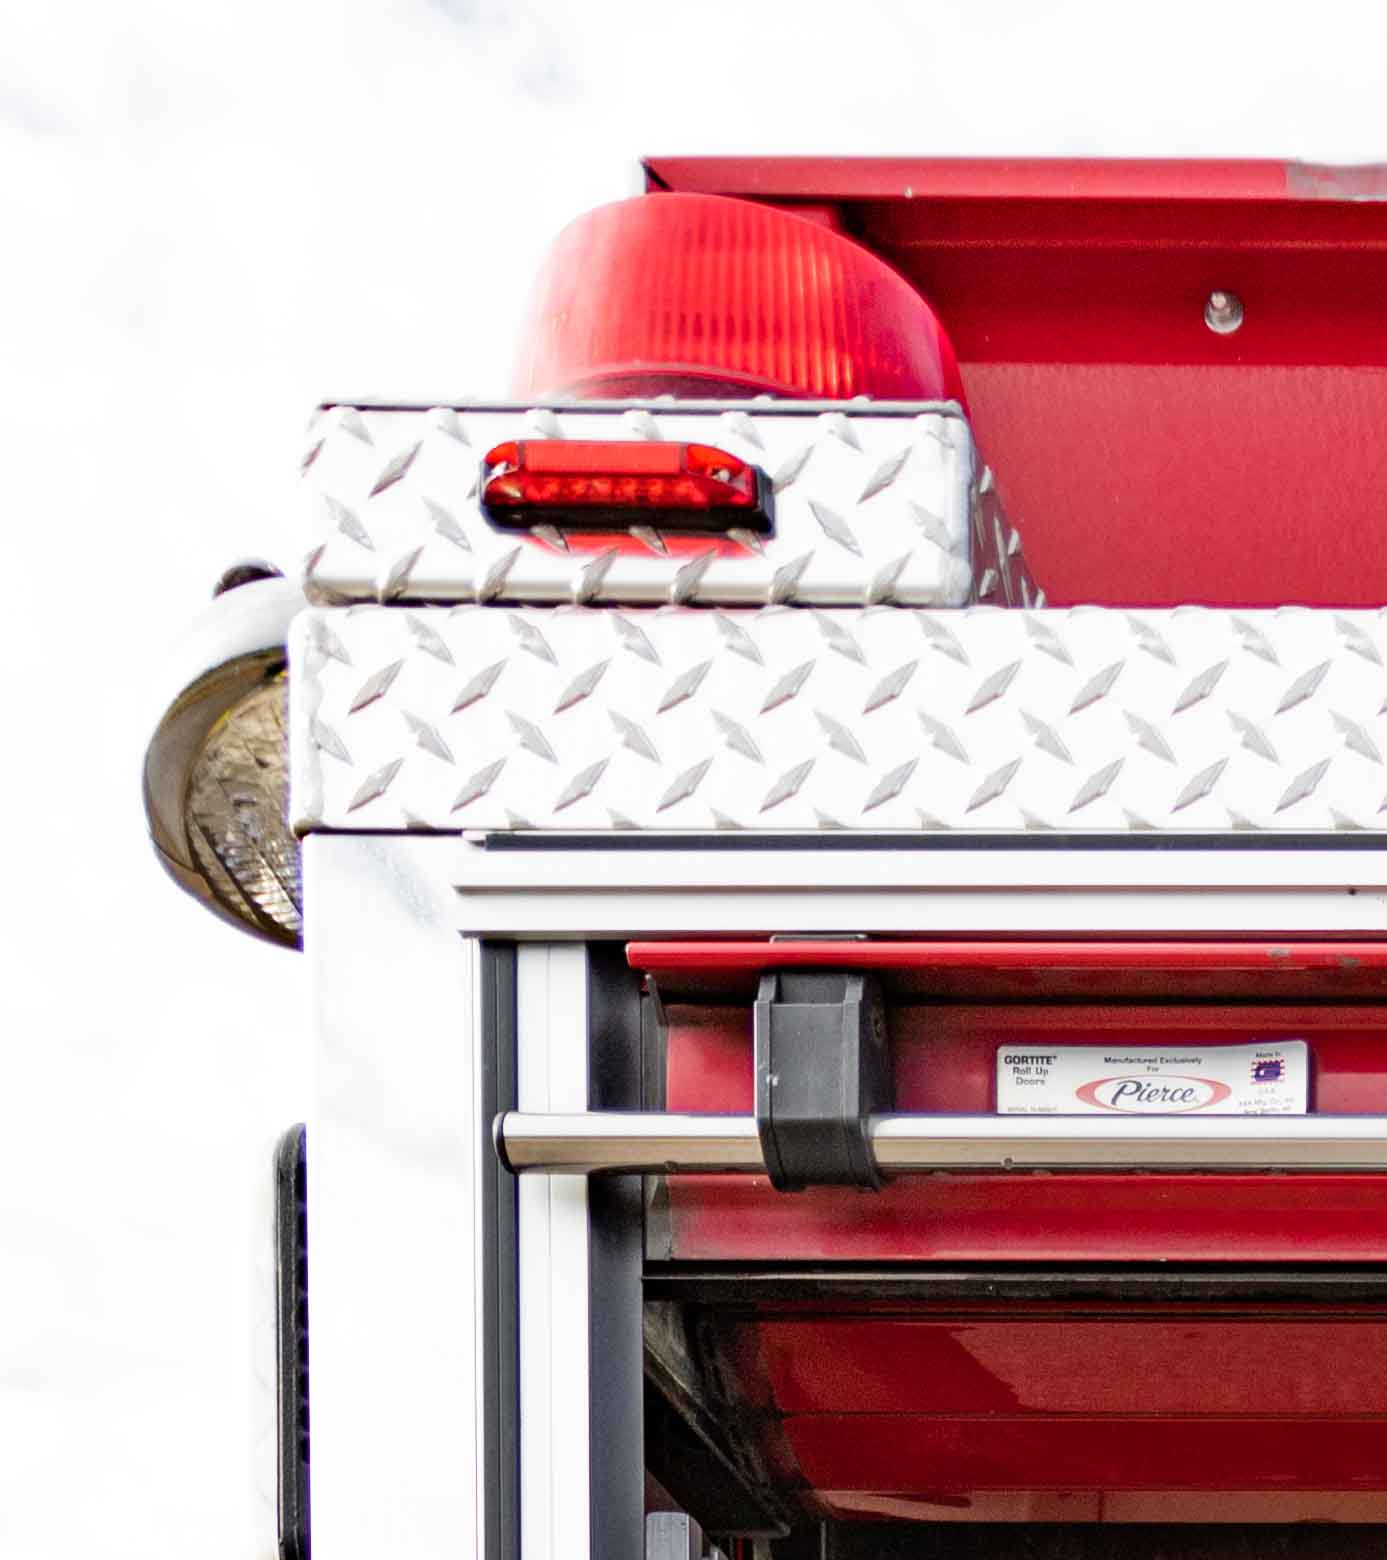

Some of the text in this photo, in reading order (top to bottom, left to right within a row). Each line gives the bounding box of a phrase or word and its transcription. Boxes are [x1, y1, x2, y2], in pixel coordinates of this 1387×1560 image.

[1104, 1056, 1202, 1066] Manufactured Exclusively
[1110, 1079, 1195, 1106] Pierce
